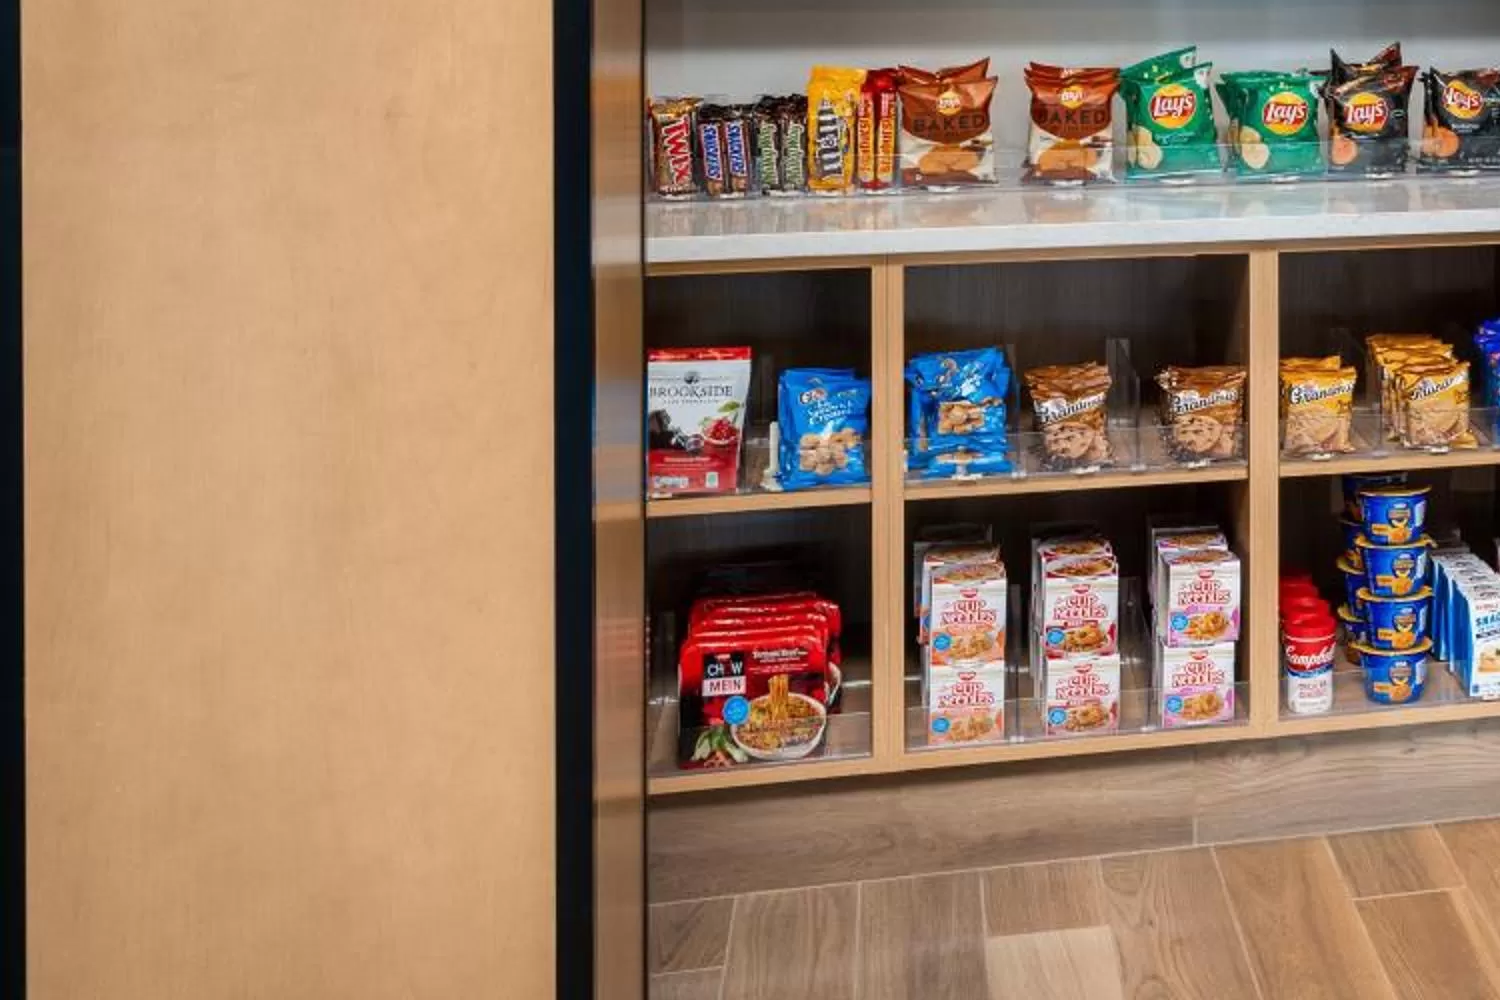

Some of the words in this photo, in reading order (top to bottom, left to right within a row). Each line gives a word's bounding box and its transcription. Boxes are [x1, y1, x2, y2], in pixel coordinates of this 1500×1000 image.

[1151, 92, 1196, 119] Lay's
[1442, 83, 1481, 110] Lay's
[1035, 108, 1109, 126] BAKED
[1266, 101, 1309, 126] Lay's
[1345, 97, 1389, 124] Lay's
[912, 113, 987, 132] BAKED
[661, 116, 692, 186] TWIX
[649, 384, 733, 400] BROOKSIDE
[707, 660, 744, 678] CHW
[709, 682, 742, 693] MEIN
